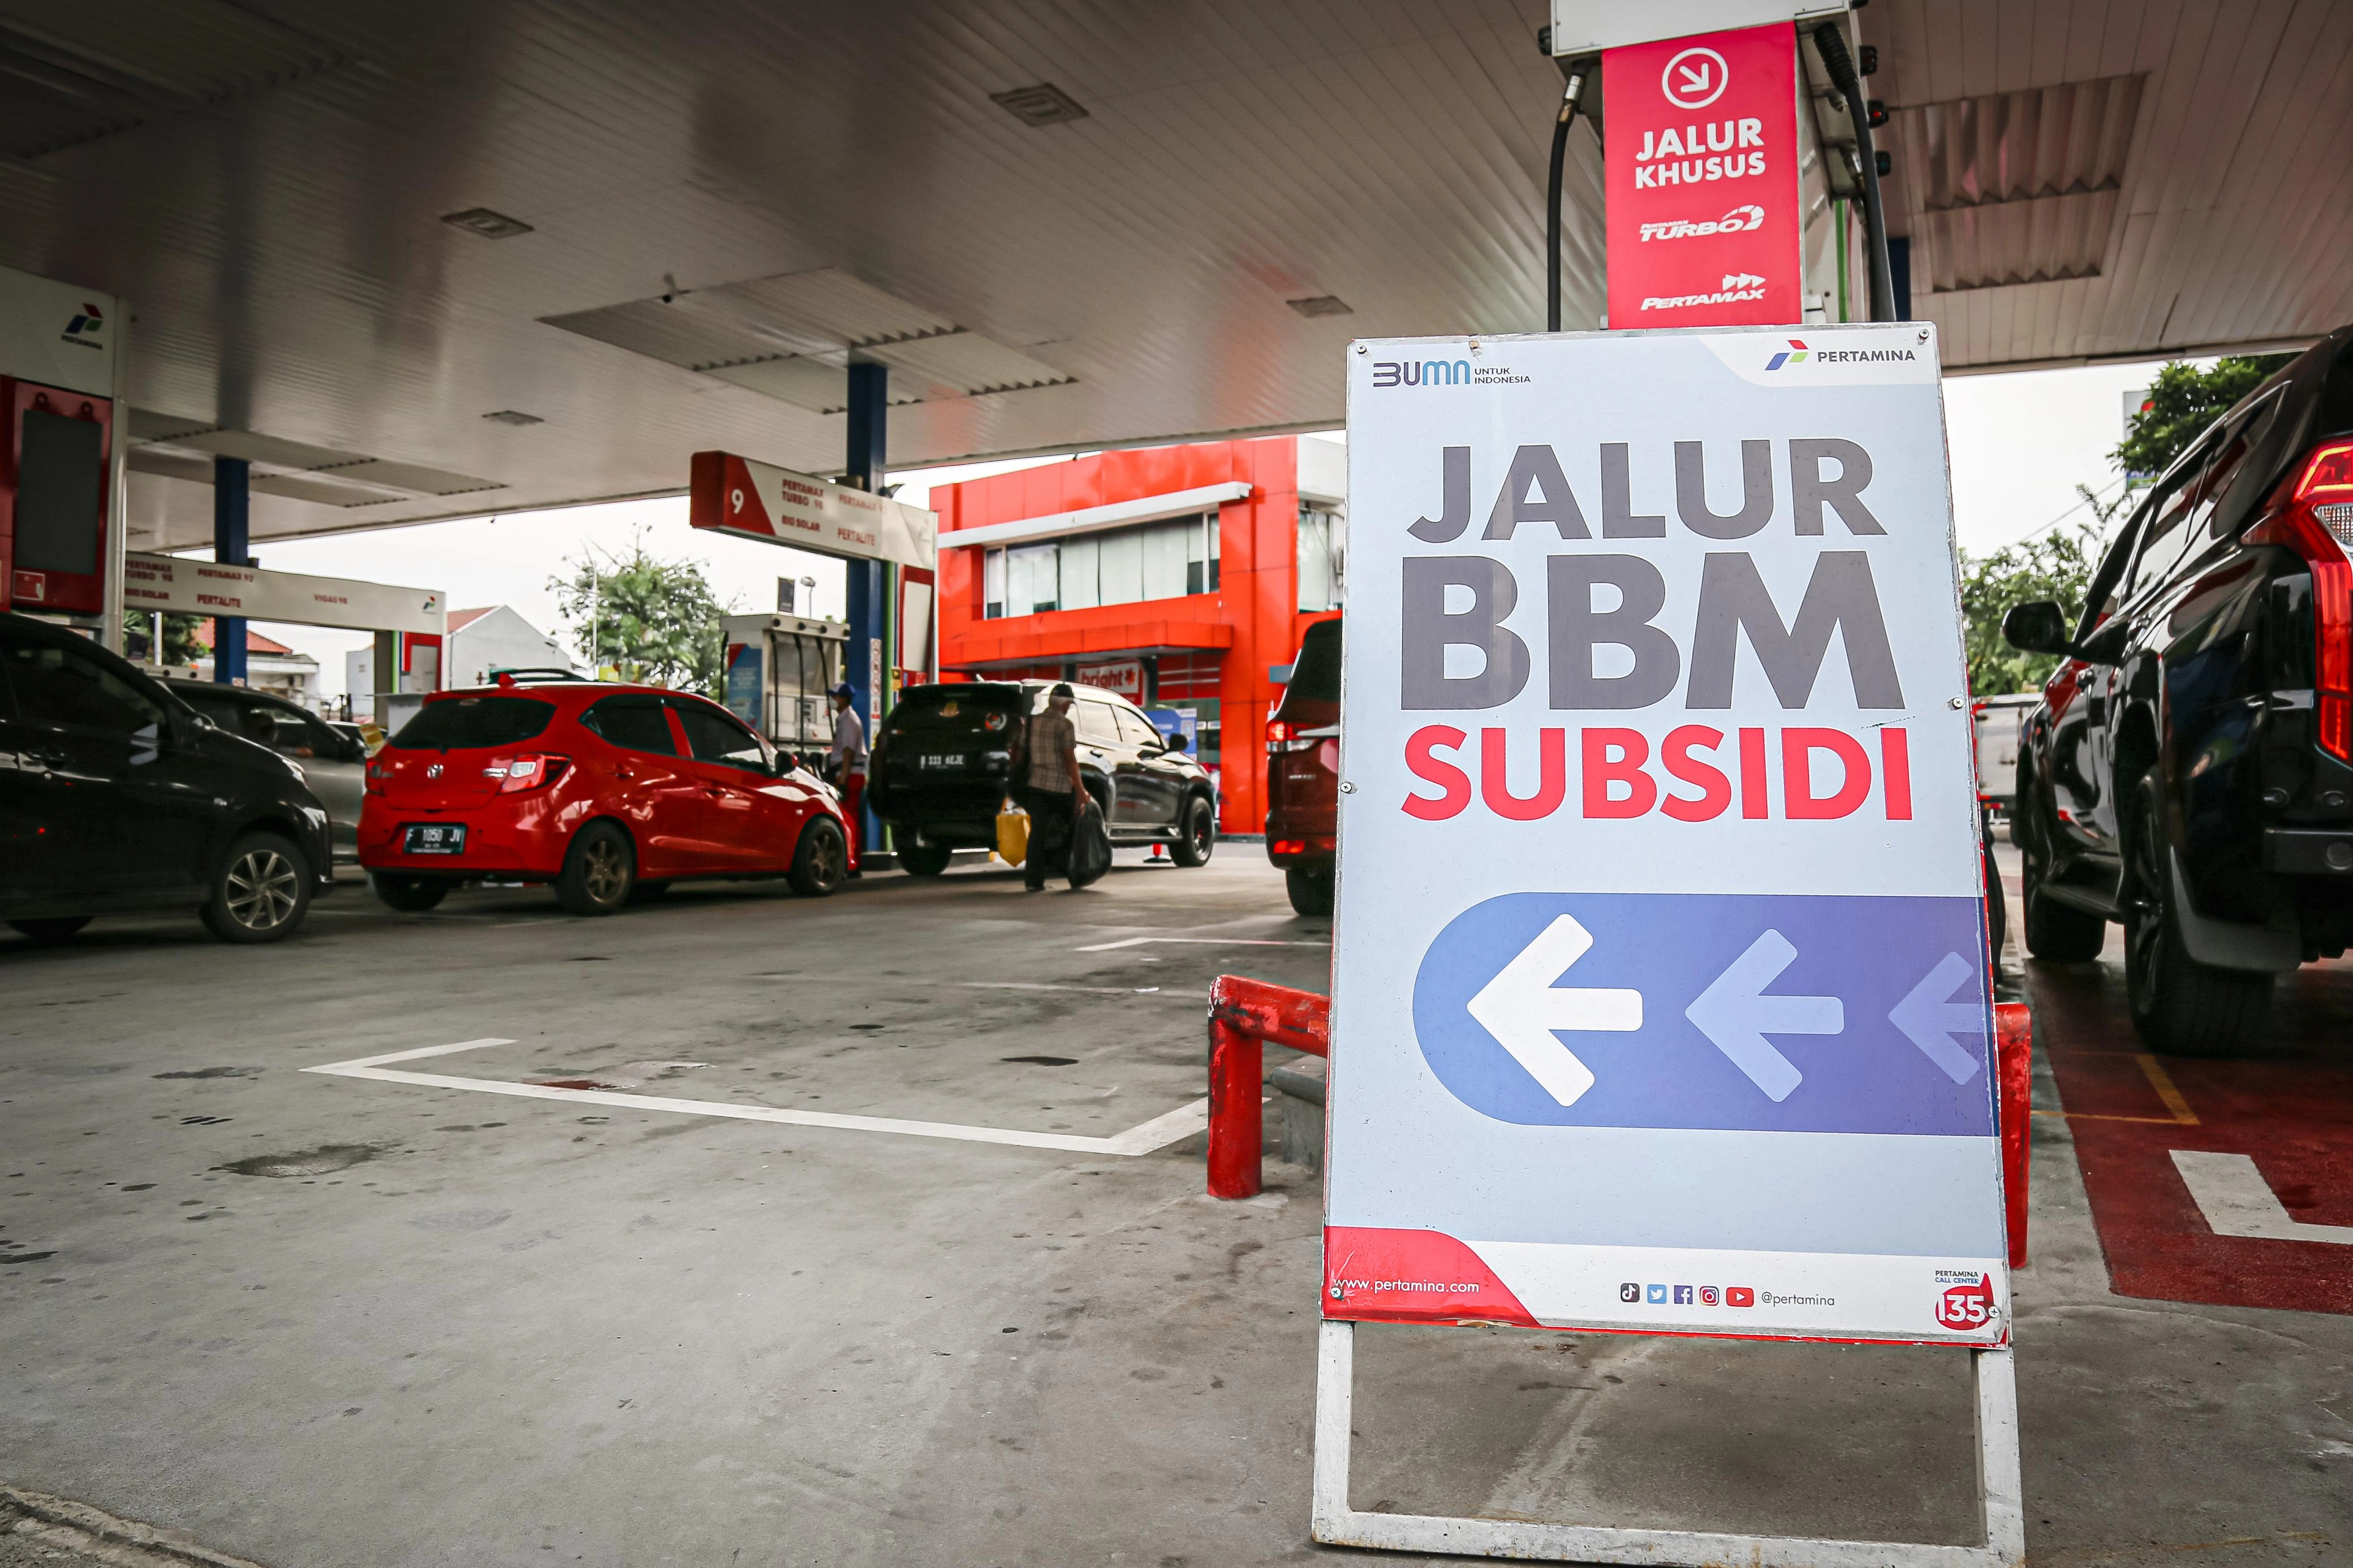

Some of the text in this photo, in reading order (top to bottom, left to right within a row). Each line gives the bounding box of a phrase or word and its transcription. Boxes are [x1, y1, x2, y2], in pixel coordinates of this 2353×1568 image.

[1636, 118, 1765, 161] JALUR
[1635, 152, 1766, 188] KHUSUS
[1640, 219, 1744, 242] TURBO
[1641, 289, 1766, 310] PERTAMAX
[1817, 350, 1916, 362] PERTAMINA
[1475, 376, 1531, 385] INDONESIA
[782, 479, 825, 497] PERTAMAX
[782, 490, 809, 506] TURBO
[1407, 438, 1888, 543] JALUR
[731, 489, 744, 513] 9
[796, 518, 820, 532] SOLAR
[1401, 550, 1906, 710] BBM
[1081, 668, 1124, 689] bright
[1400, 724, 1912, 822] SUBSIDI
[1333, 1279, 1480, 1294] www.pertamina.com
[1761, 1291, 1835, 1307] @pertamina
[1937, 1294, 1986, 1323] 135
